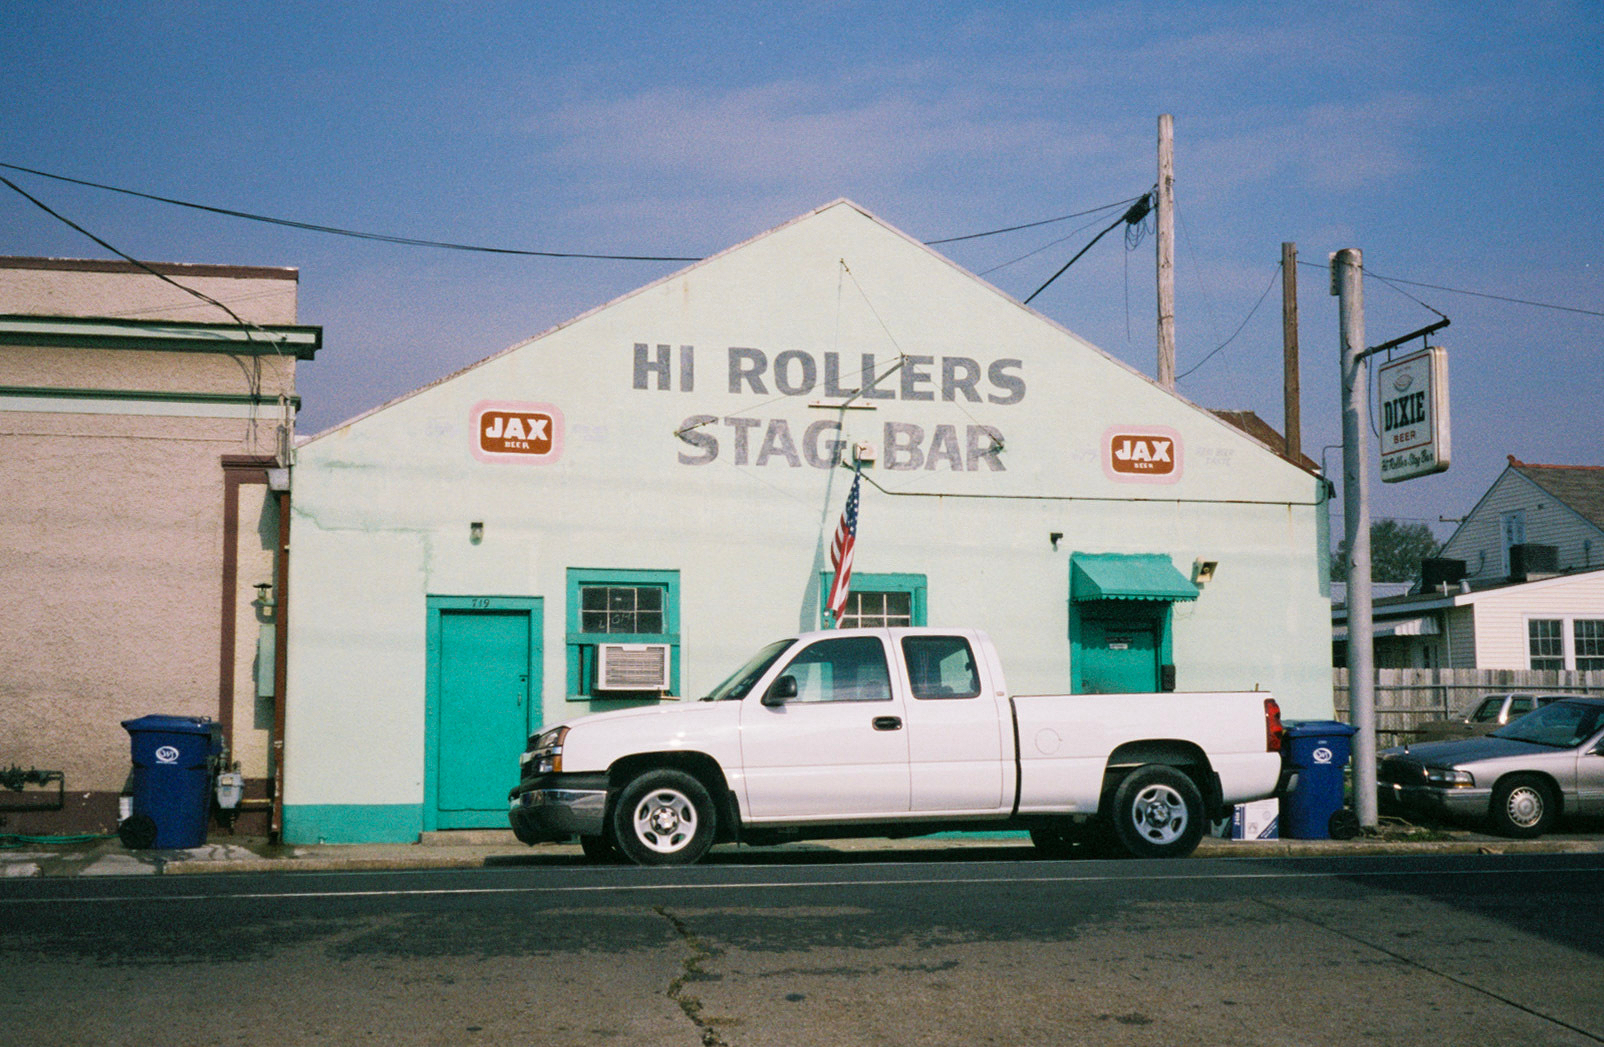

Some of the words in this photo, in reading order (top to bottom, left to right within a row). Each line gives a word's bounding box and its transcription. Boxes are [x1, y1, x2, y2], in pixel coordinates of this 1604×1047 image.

[633, 342, 694, 393] HI
[728, 346, 1027, 406] ROLLERS
[1384, 391, 1425, 433] DIXIE
[485, 417, 549, 441] JAX
[1393, 430, 1416, 444] BEER
[504, 441, 530, 450] BEER
[678, 414, 847, 470] STAG
[883, 421, 1007, 472] BAR
[1115, 440, 1171, 463] JAX
[471, 598, 490, 608] 719
